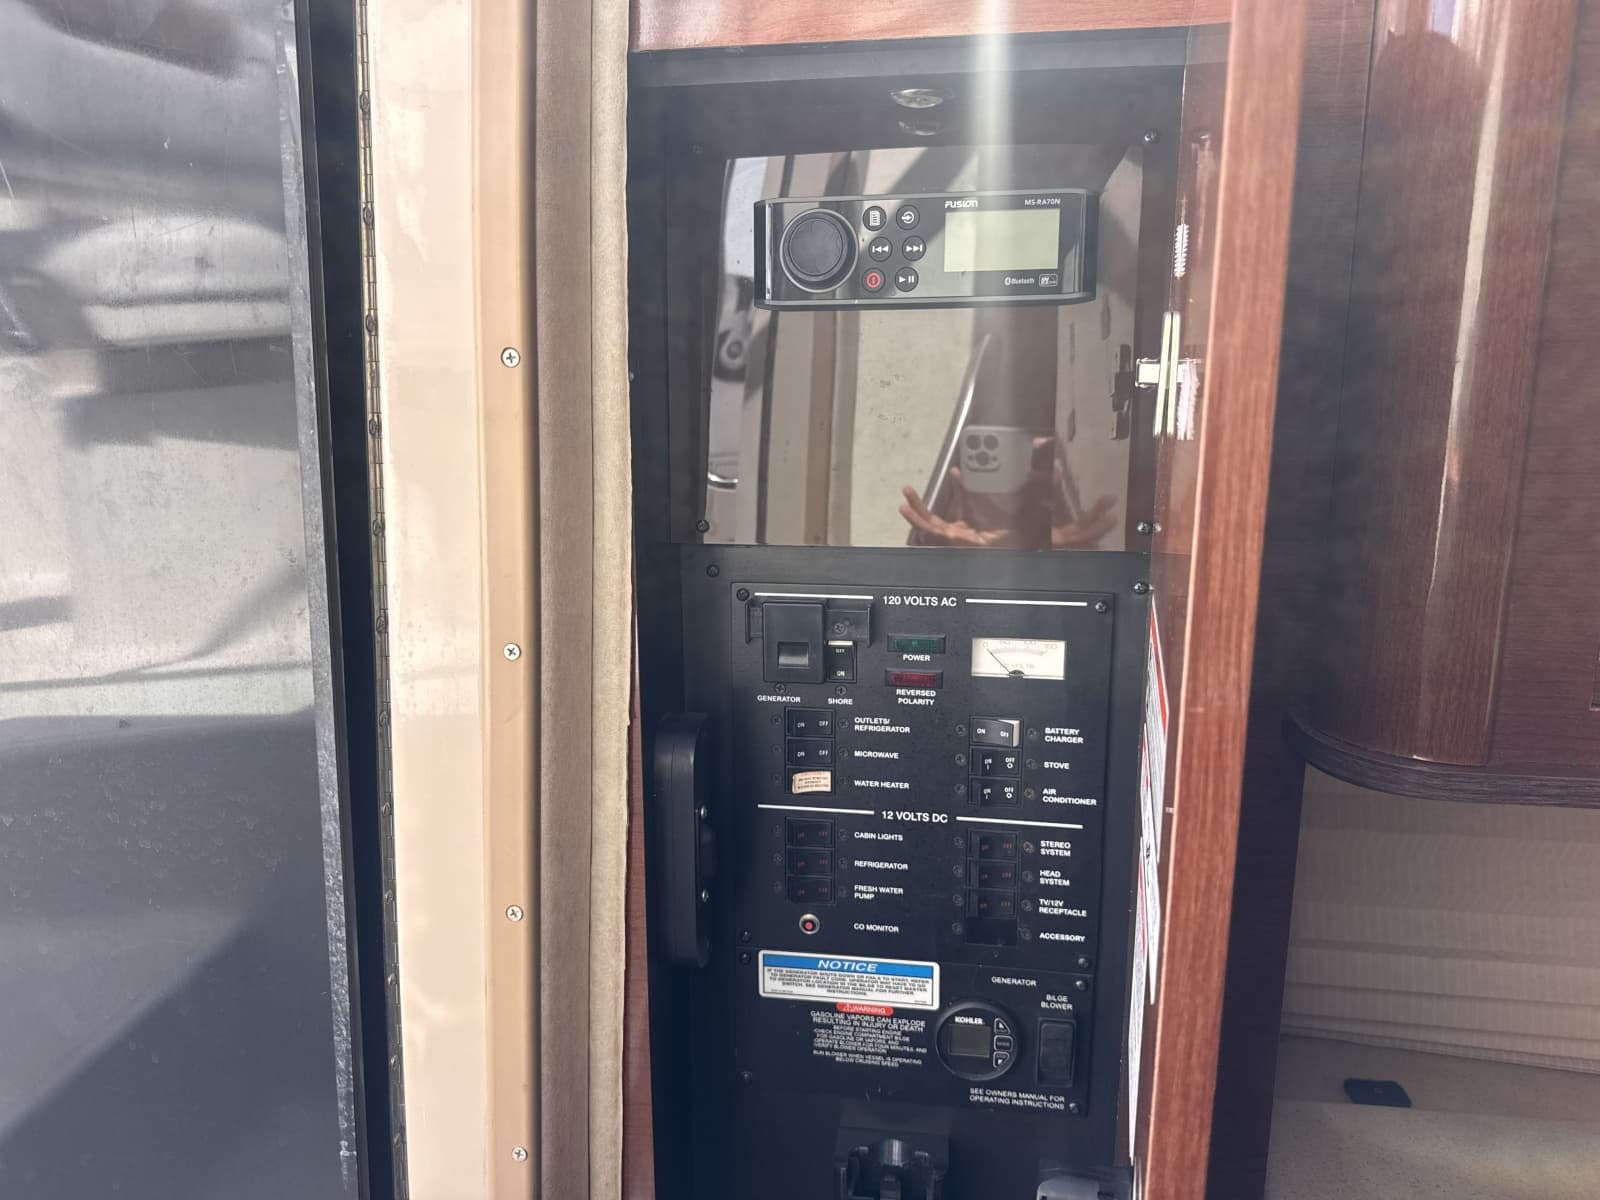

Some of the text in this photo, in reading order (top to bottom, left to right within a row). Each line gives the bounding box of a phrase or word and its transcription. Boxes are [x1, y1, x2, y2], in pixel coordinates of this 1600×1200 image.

[883, 596, 957, 607] 120 VOLTS AC
[896, 689, 936, 697] REVERSED
[757, 695, 801, 703] GENERATOR
[854, 725, 910, 733] REFRIGERATOR
[1045, 728, 1080, 736] BATTERY
[1045, 736, 1083, 744] CHARGER
[854, 751, 899, 759] MICROWAVE
[1042, 796, 1096, 805] CONDITIONER
[882, 811, 948, 823] 12 VOLTS DC
[854, 832, 903, 841] CABIN LIGHTS
[1040, 841, 1071, 849] STEREO
[1040, 848, 1071, 857] SYSTEM
[854, 861, 908, 870] REFRIGERATOR
[1039, 870, 1061, 878] HEAD
[1039, 878, 1070, 886] SYSTEM
[878, 886, 903, 894] WATER
[854, 892, 874, 900] PUMP
[1039, 899, 1064, 907] TV/12V
[1039, 907, 1087, 916] RECEPTACLE
[866, 924, 899, 932] MONITOR
[1039, 933, 1085, 942] ACCESSORY
[818, 959, 878, 972] NOTICE
[991, 977, 1037, 986] GENERATOR
[1046, 994, 1068, 1002] BILGE
[853, 1004, 886, 1013] WARNING
[1041, 1002, 1073, 1010] BLOWER
[813, 1017, 851, 1025] RESULTING
[893, 1018, 926, 1027] EXPLODE
[955, 1016, 983, 1024] KOHLER
[986, 1089, 1017, 1098] OWNERS
[1019, 1093, 1048, 1101] MANUAL
[970, 1095, 1064, 1110] OPERATING INSTRUCTIONS
